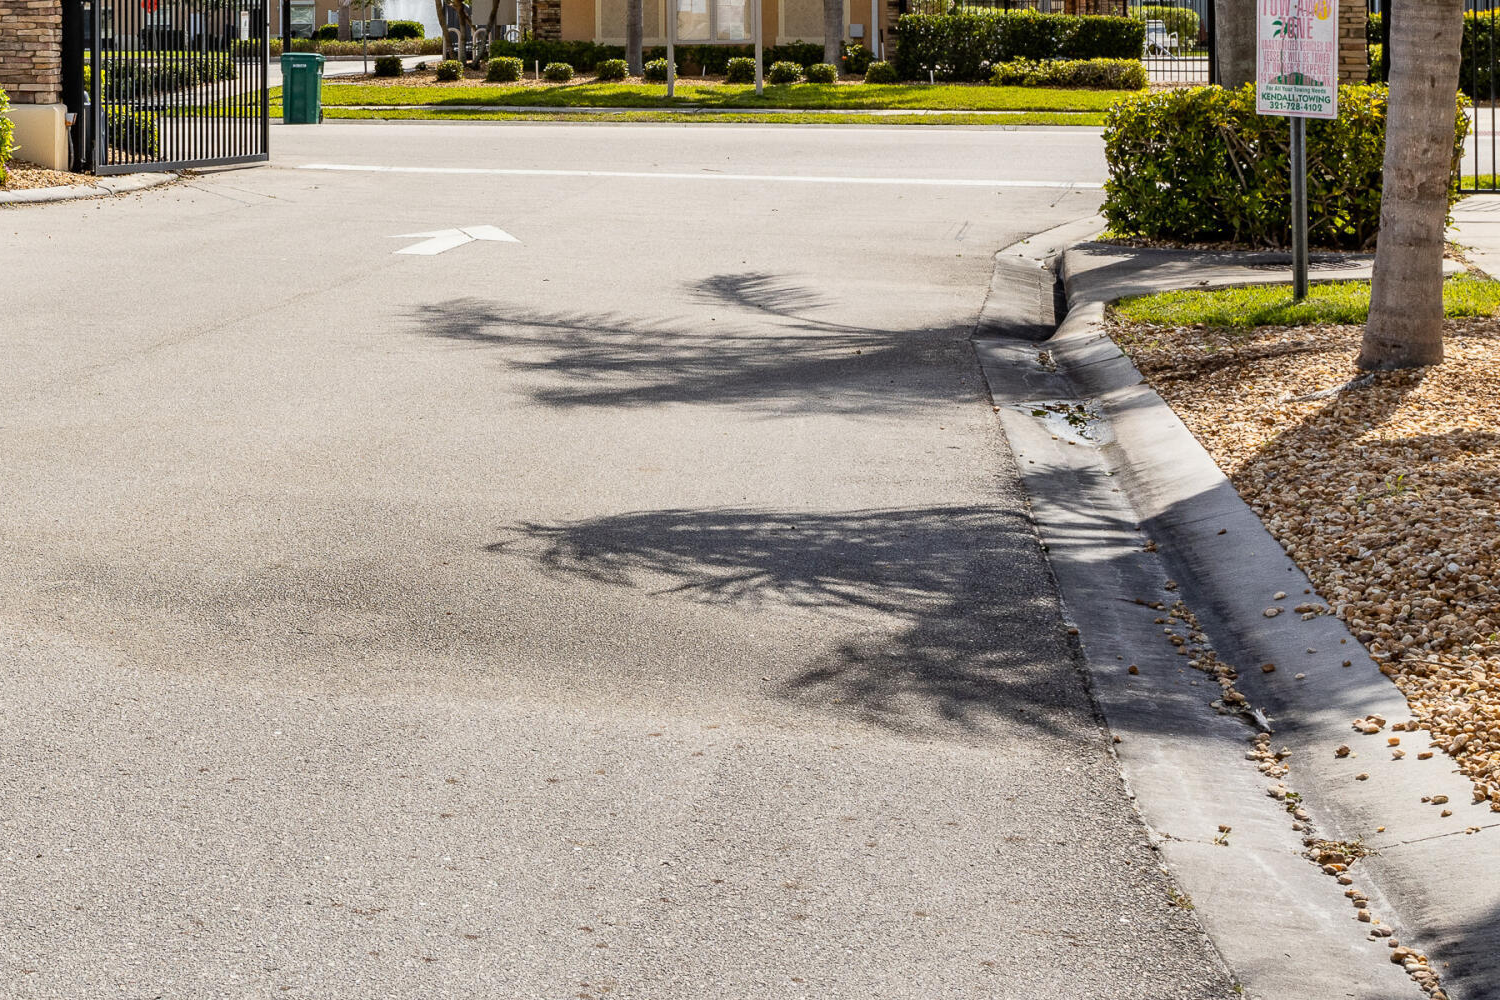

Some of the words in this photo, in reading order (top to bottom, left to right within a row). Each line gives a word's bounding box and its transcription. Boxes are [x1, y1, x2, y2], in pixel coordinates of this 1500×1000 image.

[1279, 16, 1314, 39] ZONE
[1288, 51, 1300, 62] WILL
[1294, 86, 1310, 94] Towing
[1261, 92, 1296, 102] KENDALL
[1298, 94, 1331, 104] TOWING
[1269, 101, 1323, 112] 321-728-4102
